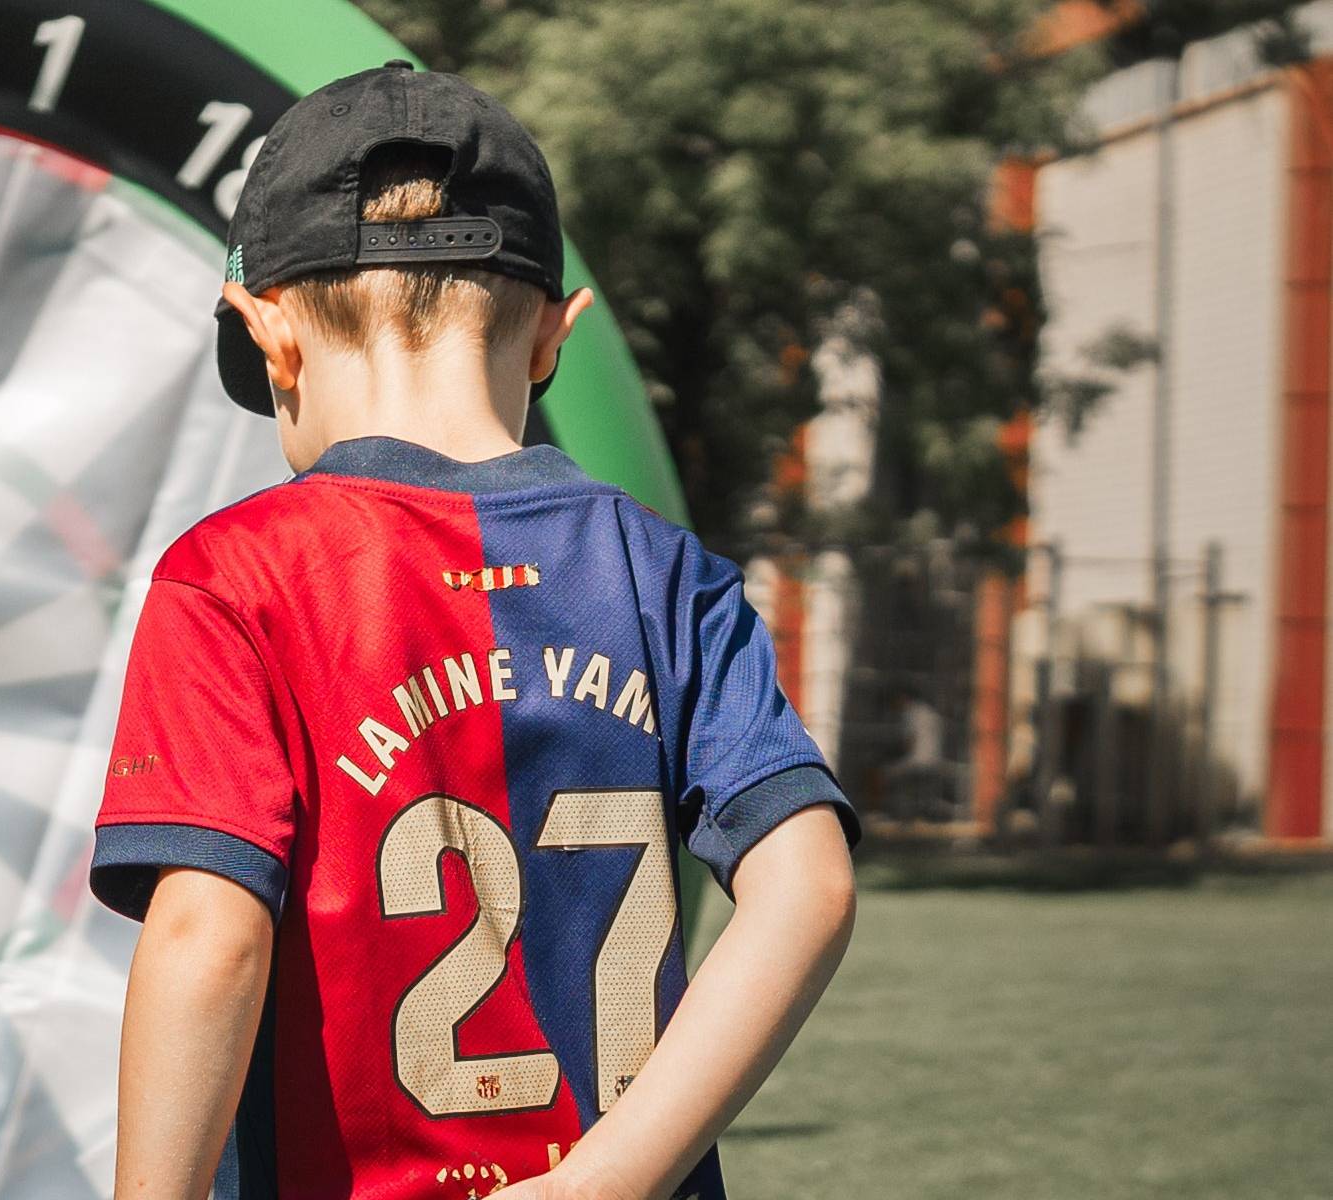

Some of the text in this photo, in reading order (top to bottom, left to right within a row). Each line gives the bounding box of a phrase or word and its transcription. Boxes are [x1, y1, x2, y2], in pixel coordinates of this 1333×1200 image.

[27, 14, 86, 113] 1
[335, 645, 662, 797] LAMINE YAM
[376, 787, 682, 1120] 27
